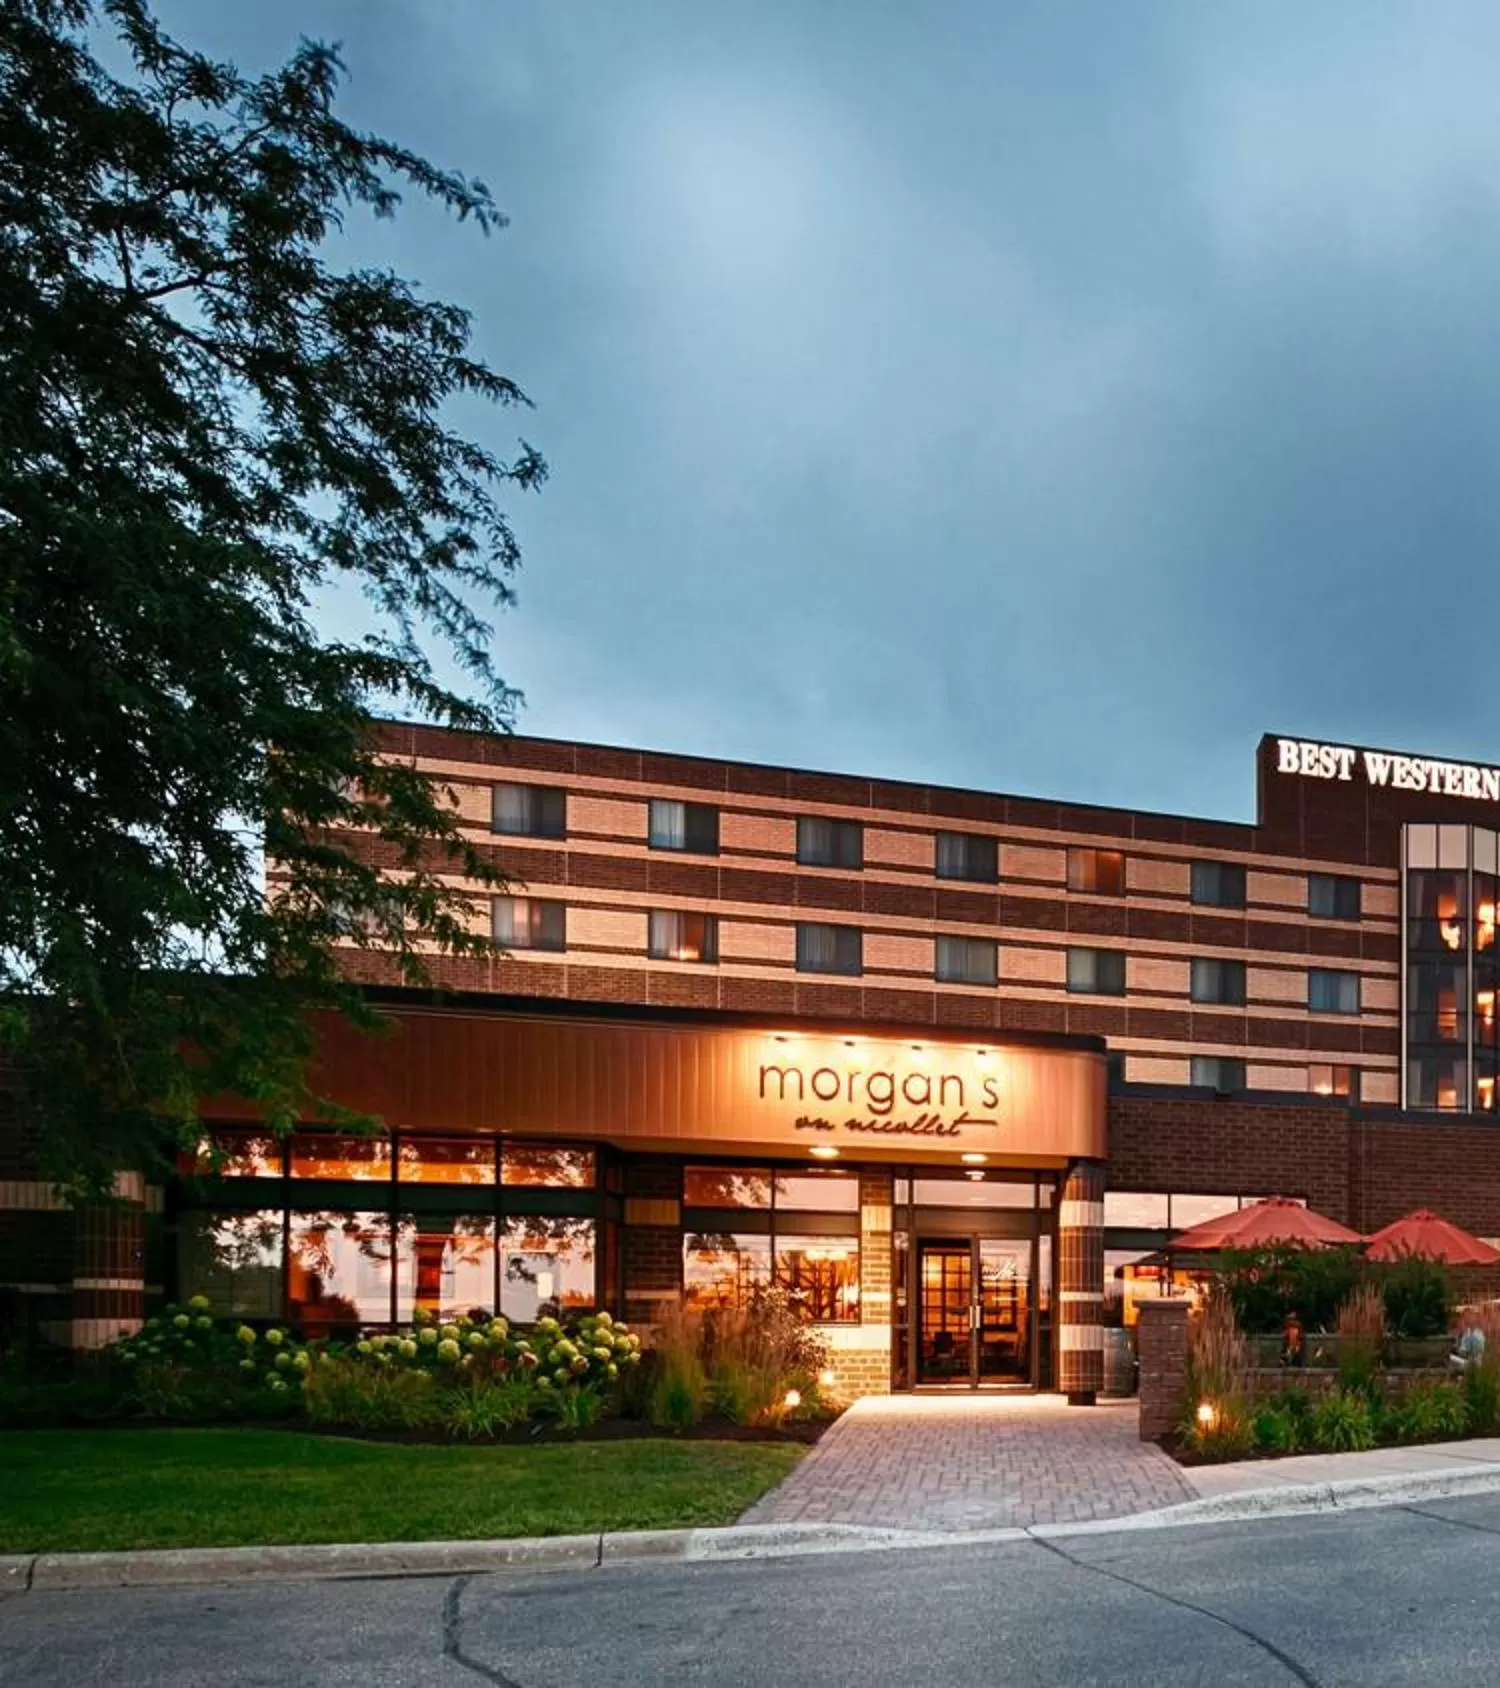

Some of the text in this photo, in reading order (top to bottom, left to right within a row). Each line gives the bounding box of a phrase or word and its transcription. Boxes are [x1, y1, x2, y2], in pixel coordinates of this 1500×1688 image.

[1277, 739, 1355, 781] BEST
[794, 1112, 998, 1137] on nicollet
